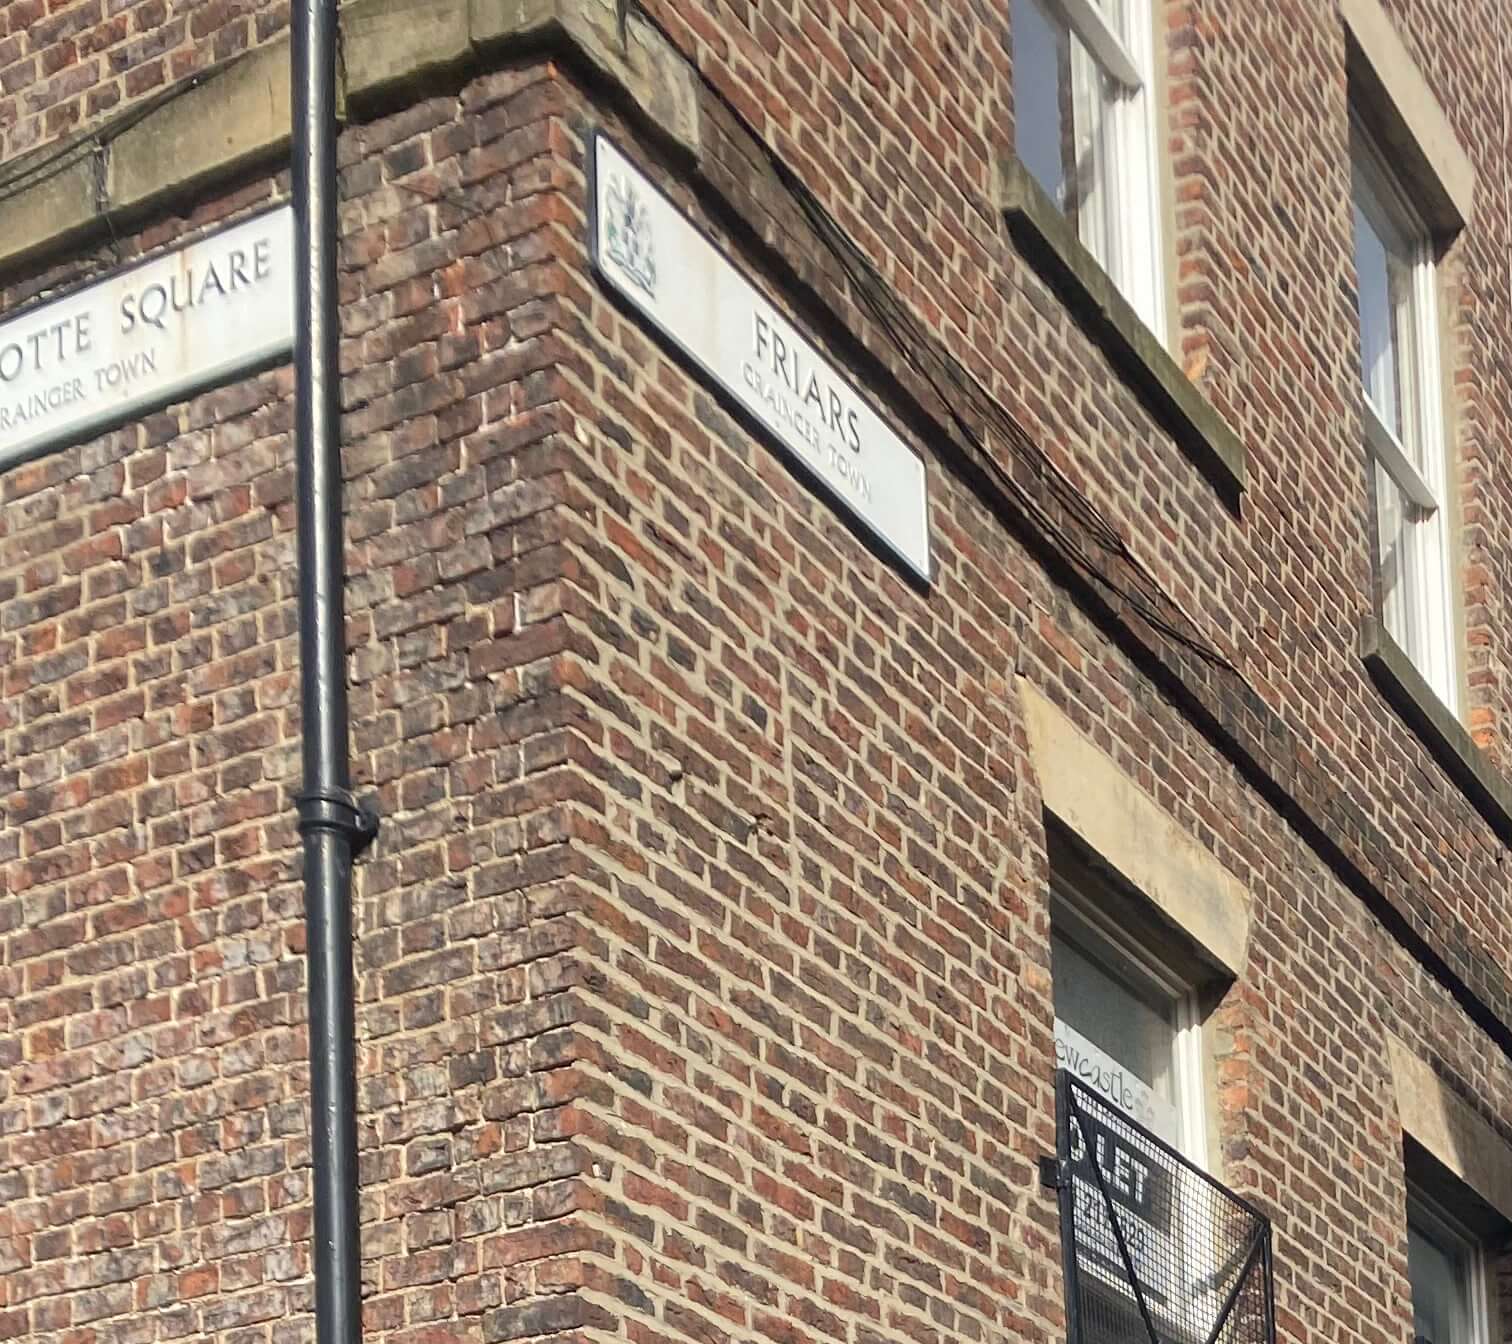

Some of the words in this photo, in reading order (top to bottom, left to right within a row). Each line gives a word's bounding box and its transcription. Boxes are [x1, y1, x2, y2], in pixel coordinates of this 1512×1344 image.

[120, 237, 272, 335] SQUARE
[94, 347, 157, 392] TOWN
[754, 311, 861, 454] FRIARS
[743, 361, 821, 453] GRAINGER
[828, 444, 872, 504] TOWN
[1096, 1133, 1149, 1204] LET
